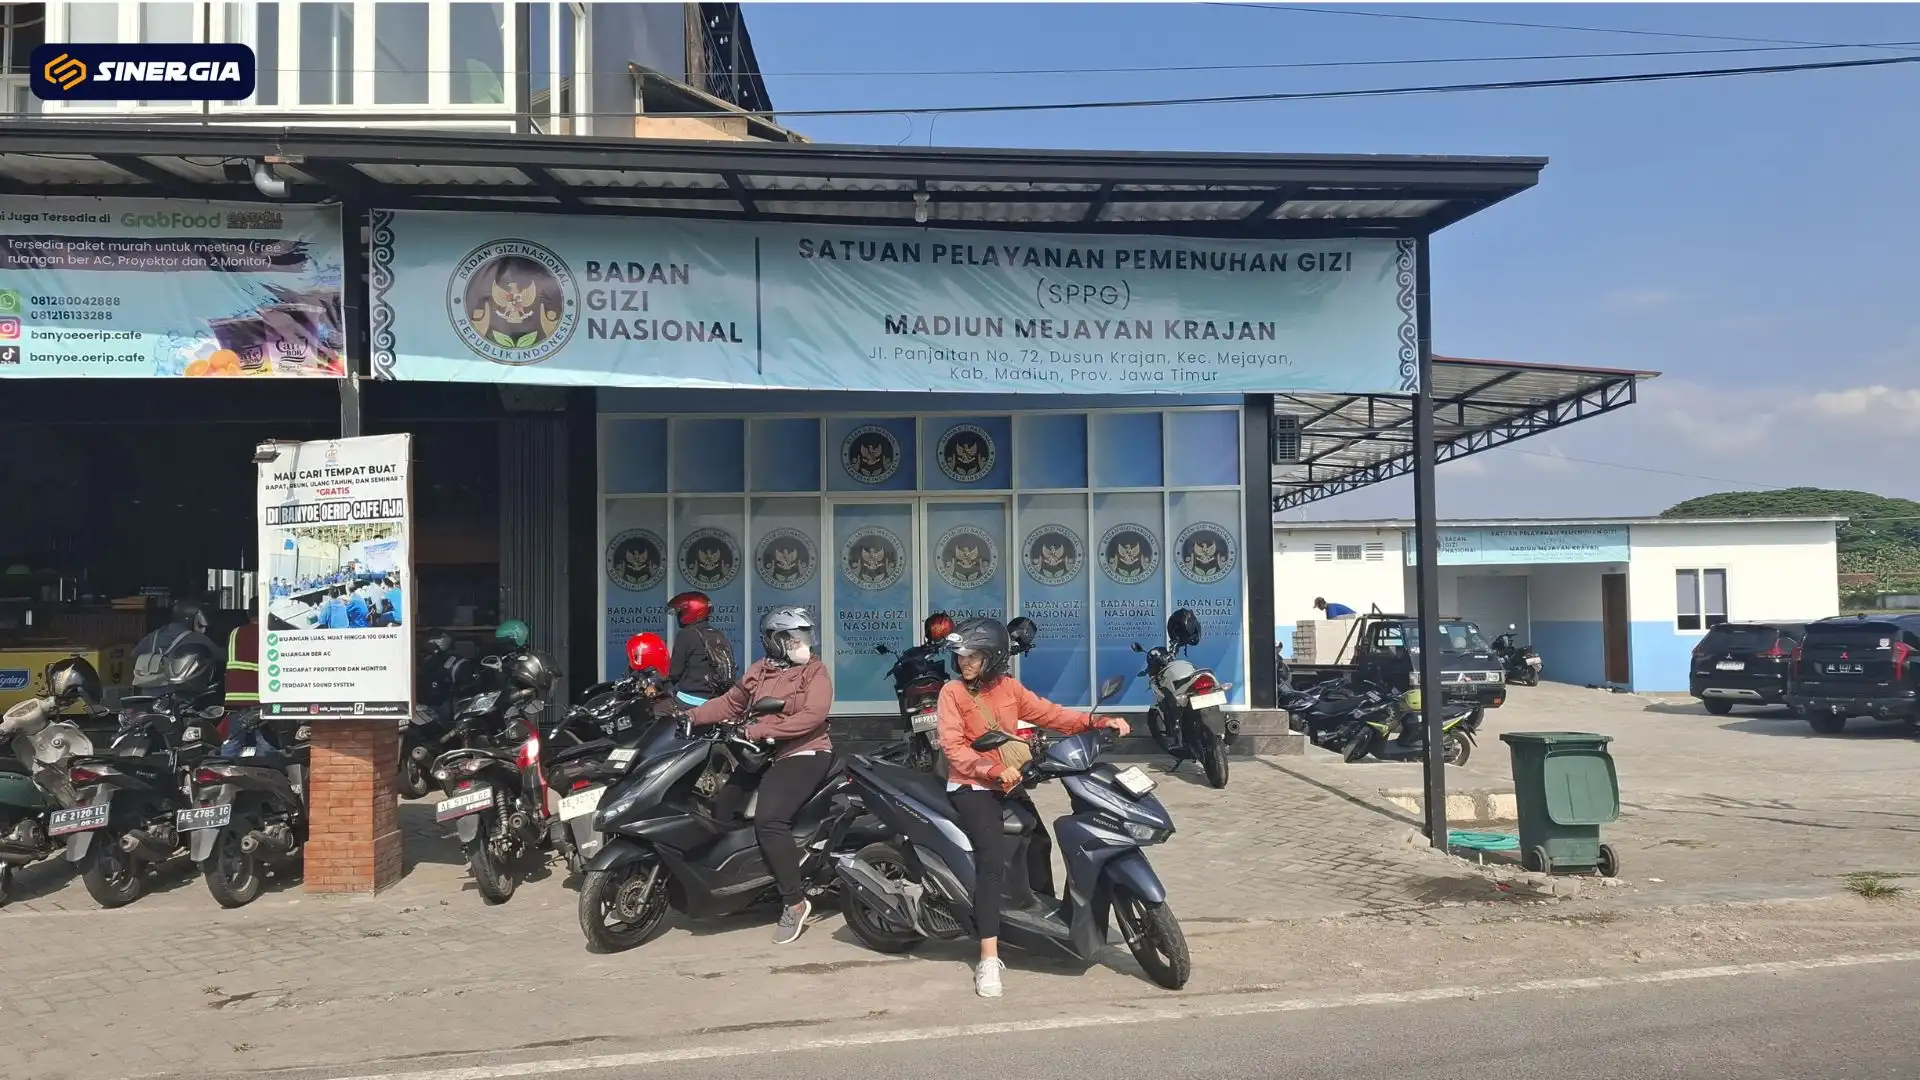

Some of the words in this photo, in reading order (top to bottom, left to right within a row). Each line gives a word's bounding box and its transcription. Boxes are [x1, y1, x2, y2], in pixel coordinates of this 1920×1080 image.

[7, 212, 39, 224] Juga
[42, 212, 96, 223] Tersedia
[99, 213, 111, 223] di
[120, 211, 221, 228] GrabFood
[8, 239, 63, 251] Tersedia
[67, 240, 105, 253] paket
[108, 241, 152, 251] murah
[155, 242, 191, 252] untuk
[194, 242, 245, 255] meeting
[249, 240, 281, 254] (Free
[8, 255, 64, 267] ruangan
[67, 255, 90, 265] ber
[93, 256, 115, 267] AC,
[118, 256, 178, 268] Proyektor
[182, 256, 206, 267] dan
[210, 256, 219, 267] 2
[221, 255, 272, 268] Monitor)
[799, 238, 921, 263] SATUAN
[932, 243, 1104, 269] PELAYANAN
[1115, 249, 1288, 272] PEMENUHAN
[1298, 252, 1352, 272] GIZI
[459, 249, 492, 280] BADAN
[495, 245, 518, 254] GIZI
[521, 246, 569, 286] NASIONAL
[586, 261, 689, 285] BADAN
[586, 290, 649, 312] GIZI
[1037, 277, 1131, 310] (SPPG)
[588, 318, 743, 344] NASIONAL
[885, 314, 1004, 337] MADIUN
[1015, 318, 1153, 340] MEJAYAN
[1164, 319, 1276, 341] KRAJAN
[31, 330, 142, 342] banyoeoerip.cafe
[459, 318, 512, 359] REPUBLIK
[518, 313, 573, 360] INDONESIA
[30, 352, 145, 364] banyoe.oerip.cafe
[869, 347, 888, 360] Jl.
[895, 347, 980, 364] Panjaitan
[987, 350, 1013, 363] No.
[1021, 350, 1043, 364] 72,
[1050, 351, 1103, 364] Dusun
[1111, 352, 1171, 367] Krajan,
[1178, 352, 1211, 365] Kec.
[1217, 353, 1293, 368] Mejayan,
[950, 367, 988, 380] Kab.
[995, 368, 1064, 383] Madiun,
[1071, 368, 1112, 382] Prov.
[1119, 369, 1164, 381] Jawa
[1171, 369, 1218, 381] Timur
[274, 472, 296, 481] MAU
[299, 470, 322, 479] CARI
[325, 466, 366, 477] TEMPAT
[369, 464, 396, 474] BUAT
[266, 506, 280, 526] DI
[280, 503, 321, 525] BANYOE
[352, 500, 380, 520] CAFE
[381, 498, 403, 518] AJA
[719, 605, 739, 613] GIZI
[1025, 600, 1059, 609] BADAN
[1063, 600, 1083, 608] GIZI
[1101, 600, 1135, 608] BADAN
[1139, 600, 1159, 608] GIZI
[1215, 599, 1236, 607] GIZI
[607, 606, 642, 616] BADAN
[840, 611, 880, 620] BADAN
[883, 610, 909, 619] GIZI
[978, 609, 1001, 618] GIZI
[1028, 610, 1080, 618] NASIONAL
[1104, 609, 1156, 617] NASIONAL
[611, 616, 663, 624] NASIONAL
[843, 621, 903, 631] NASIONAL
[55, 813, 67, 823] AE
[70, 810, 91, 820] 2120
[95, 807, 105, 815] IL
[180, 812, 191, 821] AE
[194, 809, 215, 818] 4785
[219, 806, 229, 815] IG
